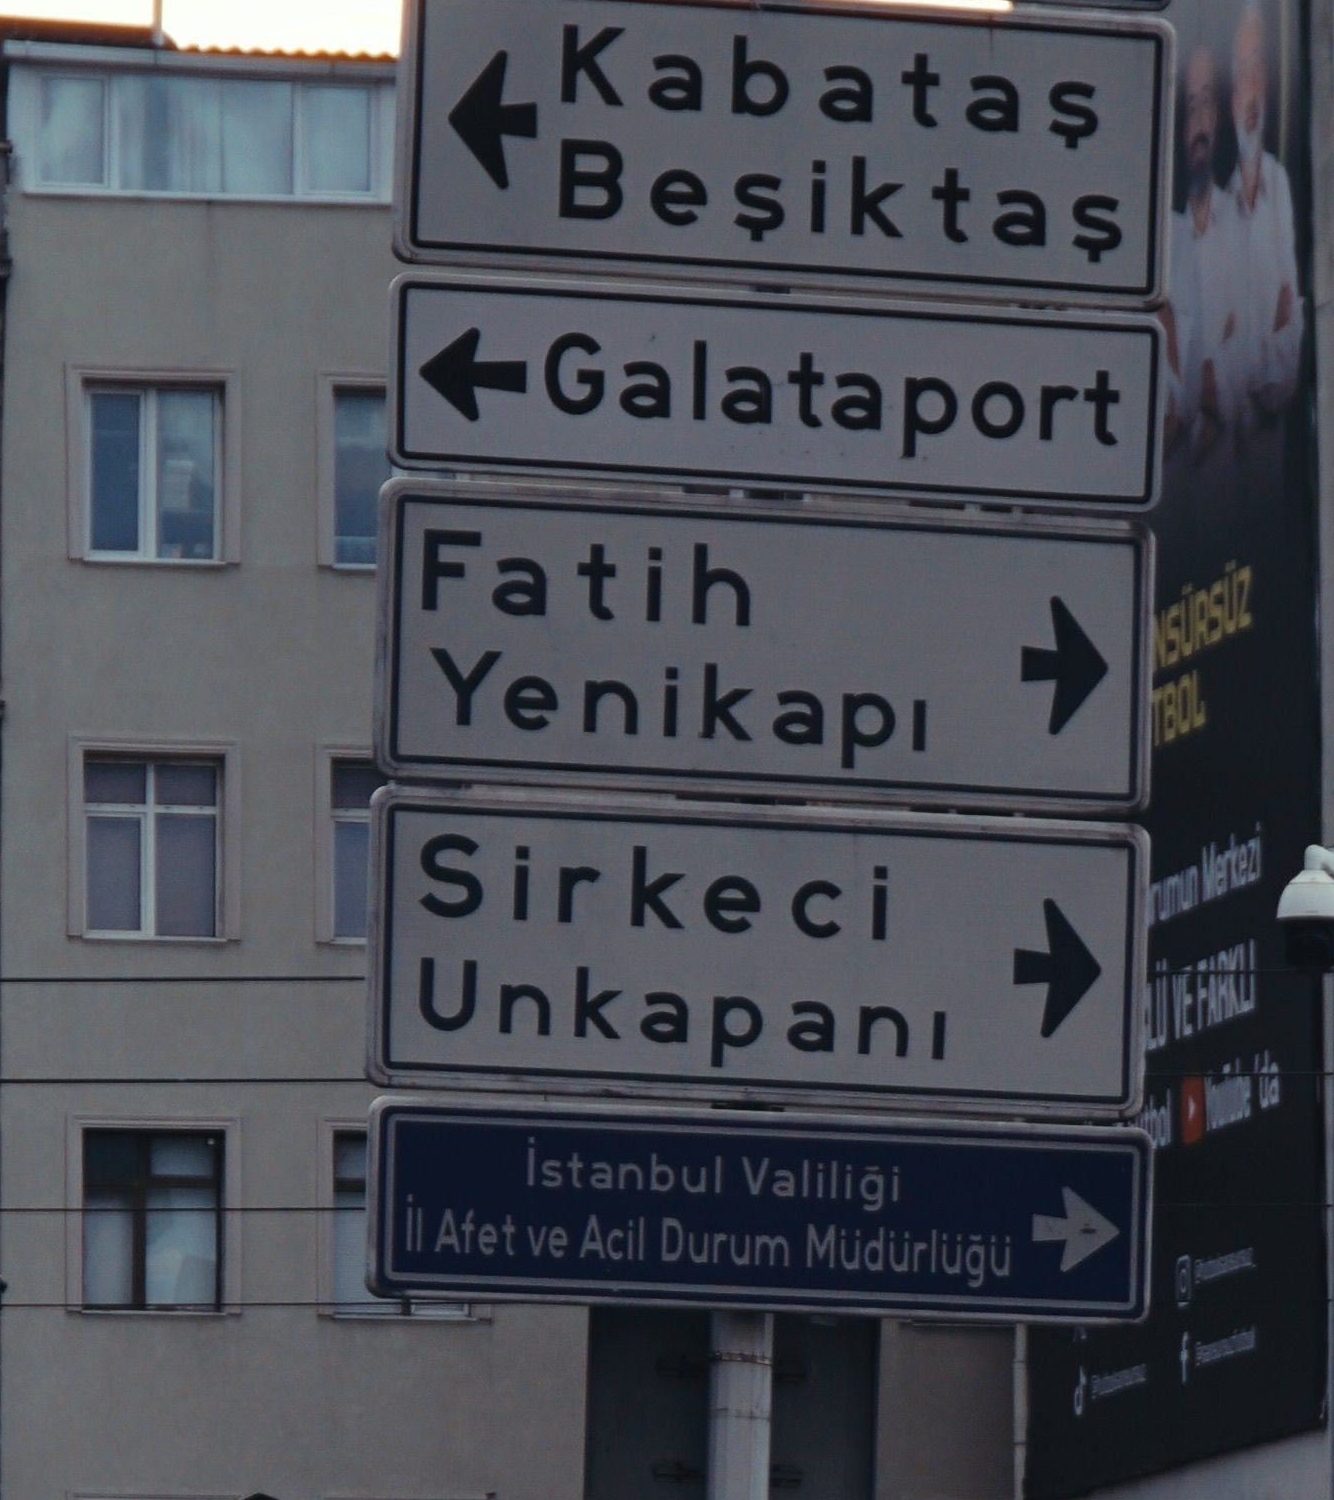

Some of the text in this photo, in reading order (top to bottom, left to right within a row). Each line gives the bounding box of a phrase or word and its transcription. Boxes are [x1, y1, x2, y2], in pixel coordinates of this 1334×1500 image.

[560, 23, 1099, 149] Kabataş
[558, 139, 1124, 263] Beşiktaş
[544, 332, 1120, 459] Galataport
[421, 528, 752, 626] Fatih
[430, 647, 927, 769] Yenikapı
[419, 834, 889, 941] Sirkeci
[1202, 821, 1261, 902] Merkezi
[418, 957, 946, 1067] Unkapanı
[1197, 938, 1257, 1030] FARKLI
[526, 1138, 902, 1212] İstanbul Valiliği
[406, 1194, 1012, 1289] İl Afet ve Acil Durum Müdürlüğü
